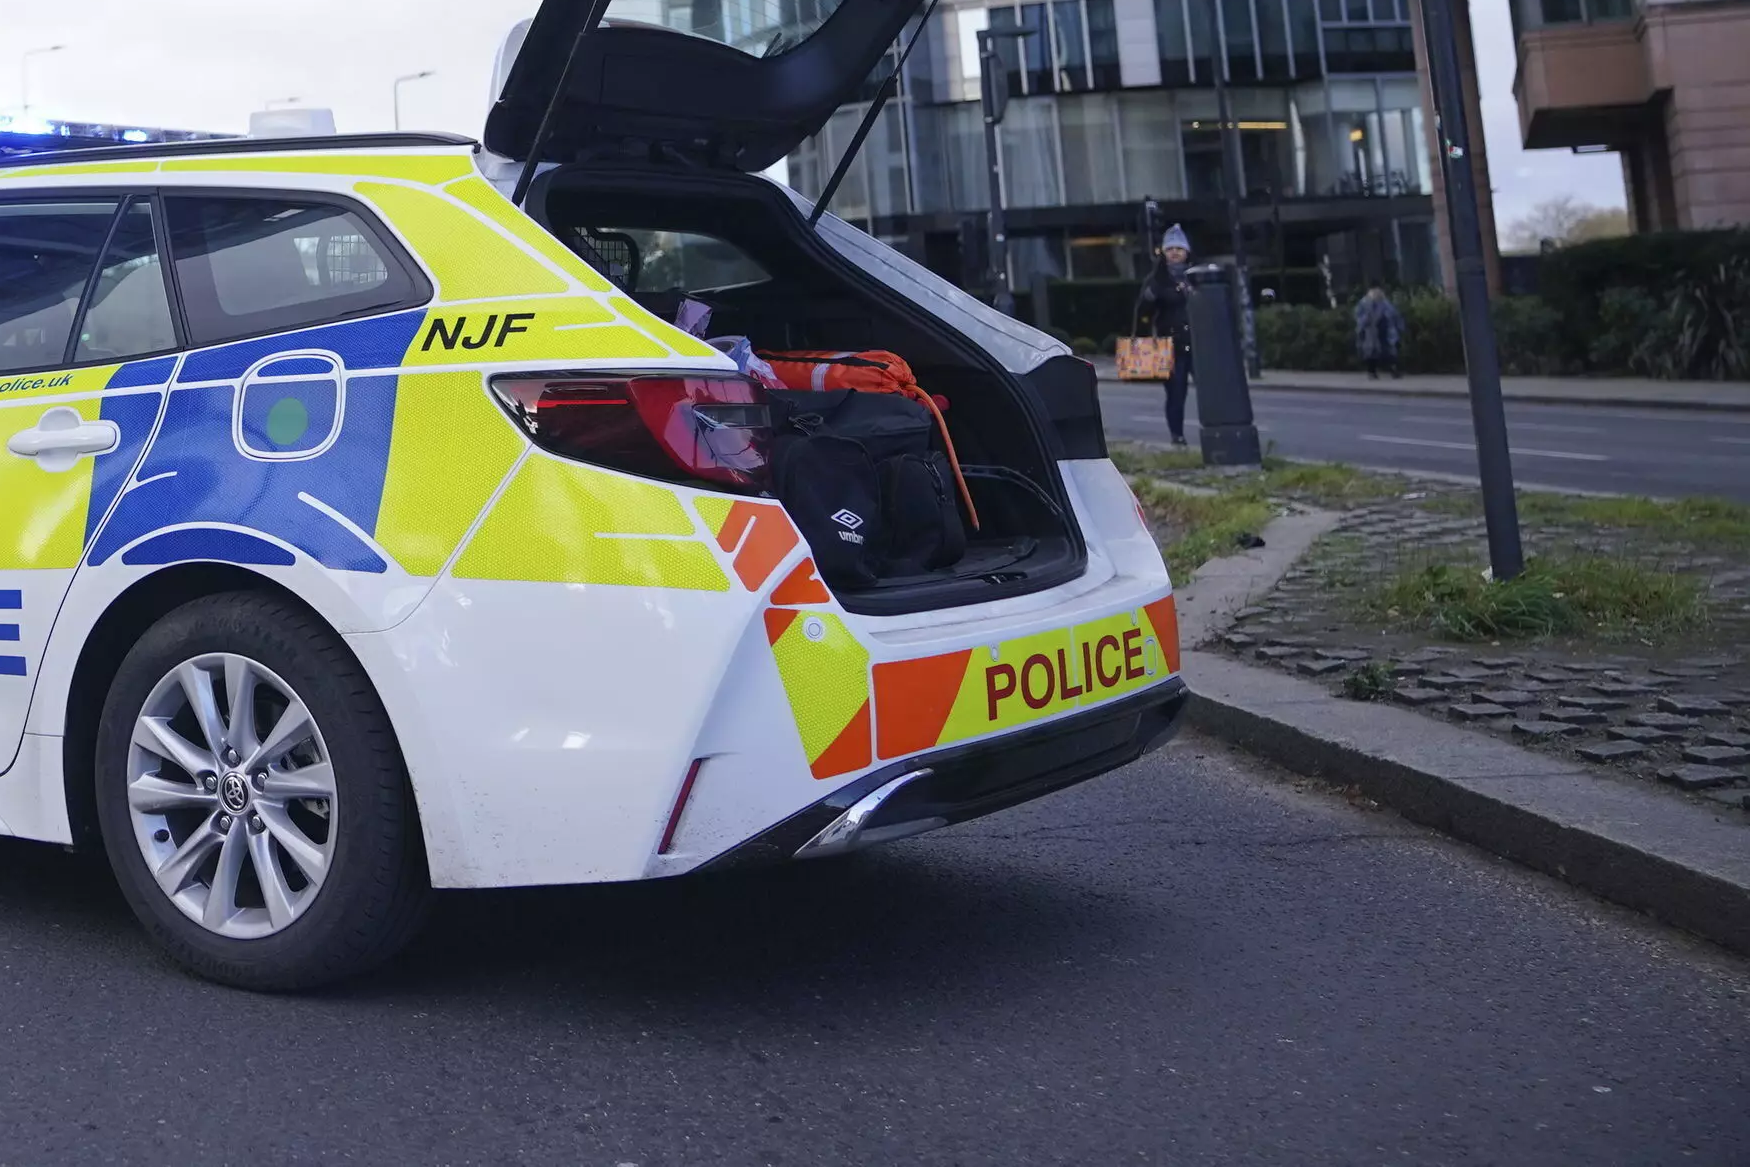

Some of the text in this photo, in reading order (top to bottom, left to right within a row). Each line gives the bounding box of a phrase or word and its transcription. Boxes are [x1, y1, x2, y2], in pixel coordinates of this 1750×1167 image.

[421, 313, 536, 352] NJF
[837, 530, 864, 545] umbr
[985, 627, 1145, 722] POLICE
